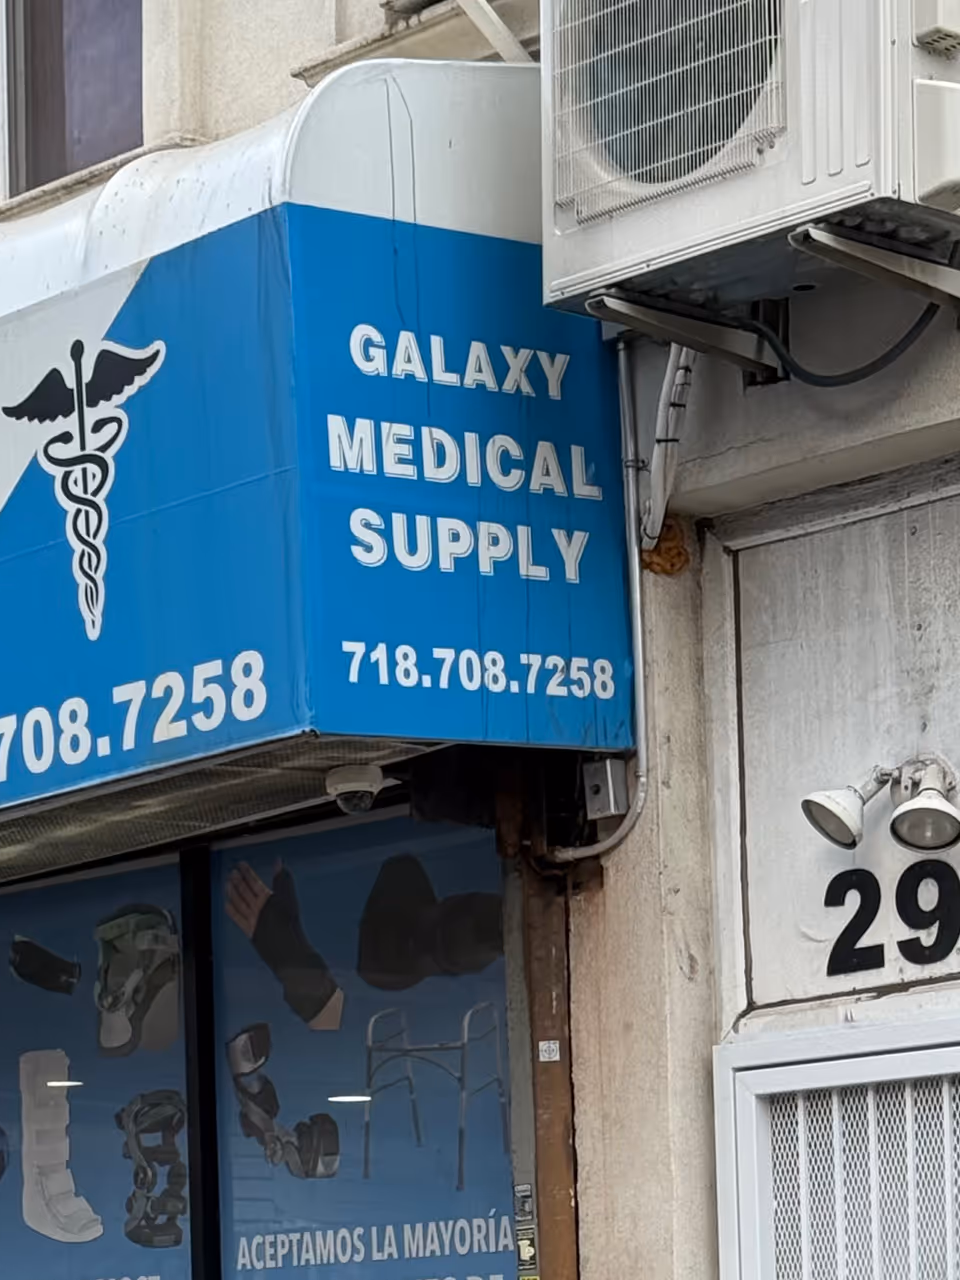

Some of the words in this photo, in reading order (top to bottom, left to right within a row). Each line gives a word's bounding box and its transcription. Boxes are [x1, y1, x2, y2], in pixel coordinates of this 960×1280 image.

[349, 323, 570, 400] GALAXY
[327, 414, 603, 500] MEDICAL
[349, 507, 589, 584] SUPPLY
[342, 640, 615, 700] 718.708.7258
[237, 1227, 365, 1271] ACEPTAMOS
[371, 1225, 398, 1261] LA
[404, 1209, 515, 1258] MAYORÍA
